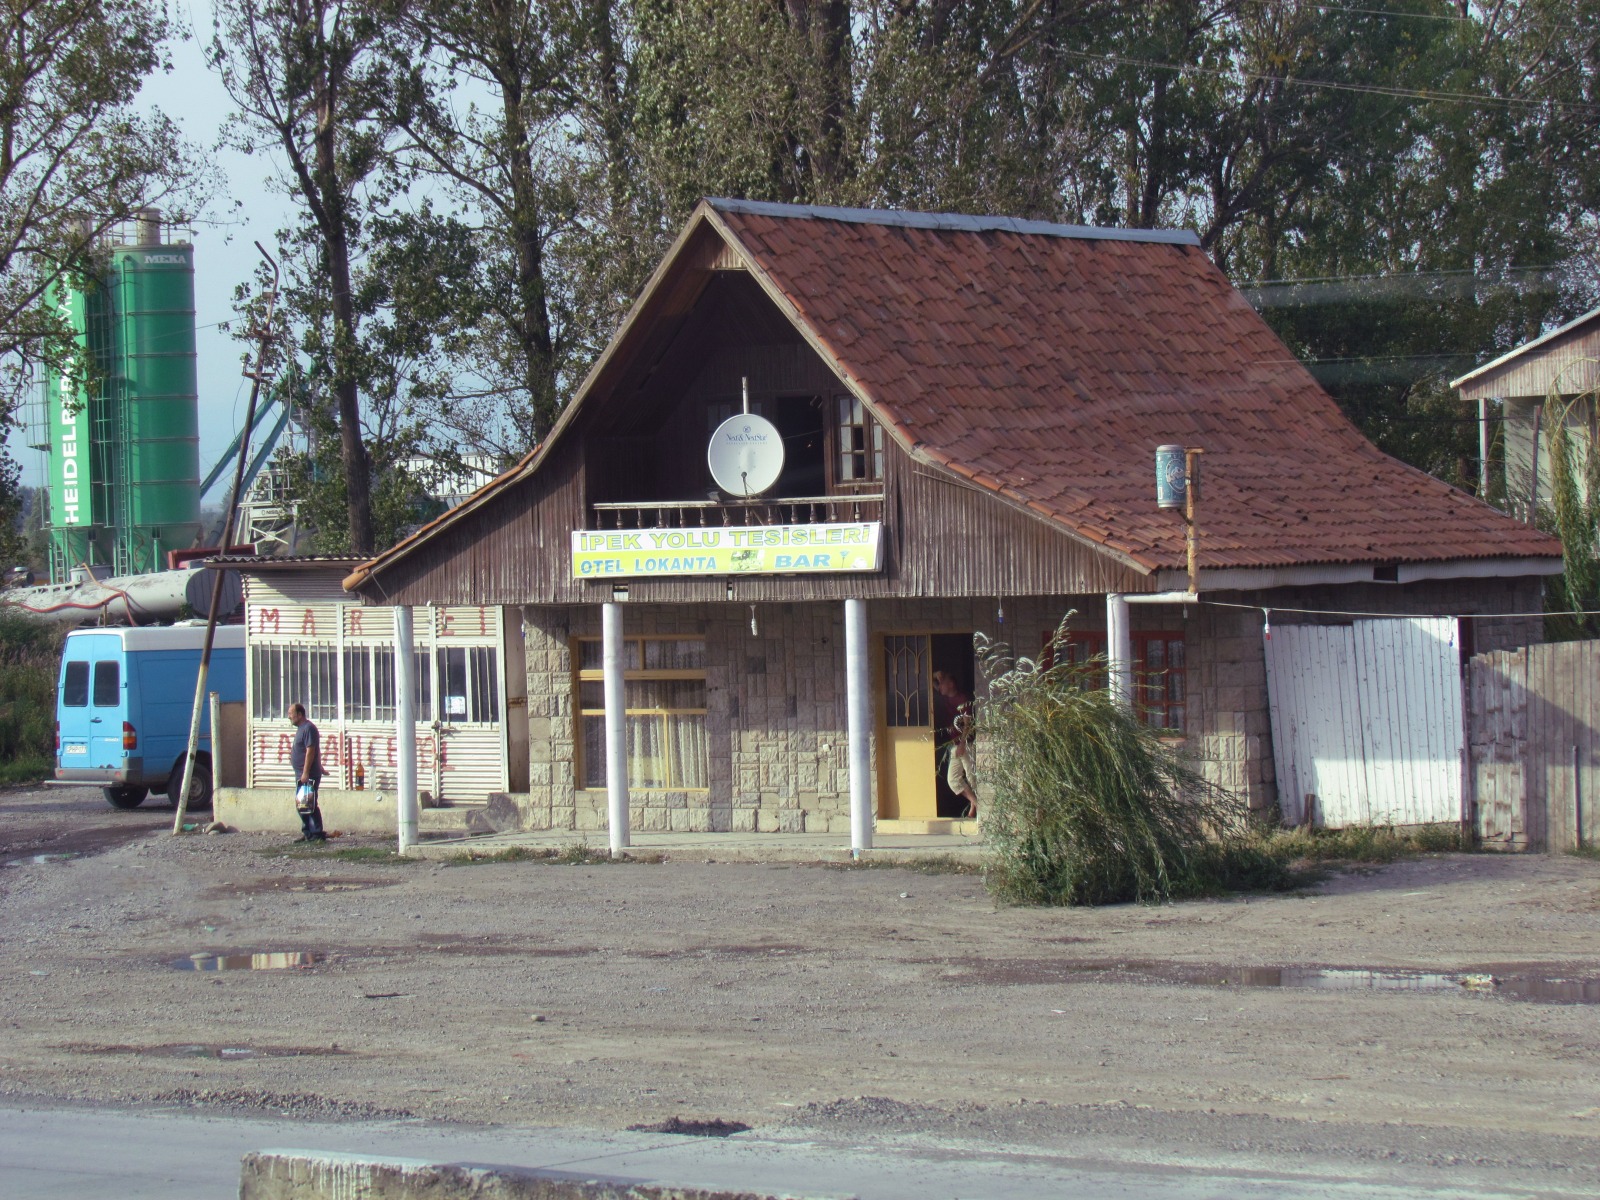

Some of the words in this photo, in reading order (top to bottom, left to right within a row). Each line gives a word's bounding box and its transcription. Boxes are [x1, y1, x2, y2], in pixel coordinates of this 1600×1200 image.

[144, 254, 187, 264] MEKA
[580, 533, 641, 551] İPEK
[648, 531, 721, 549] YOLU
[728, 524, 871, 547] TESİSLERİ
[580, 559, 625, 574] OTEL
[634, 556, 717, 572] LOKANTA
[774, 553, 832, 568] BAR
